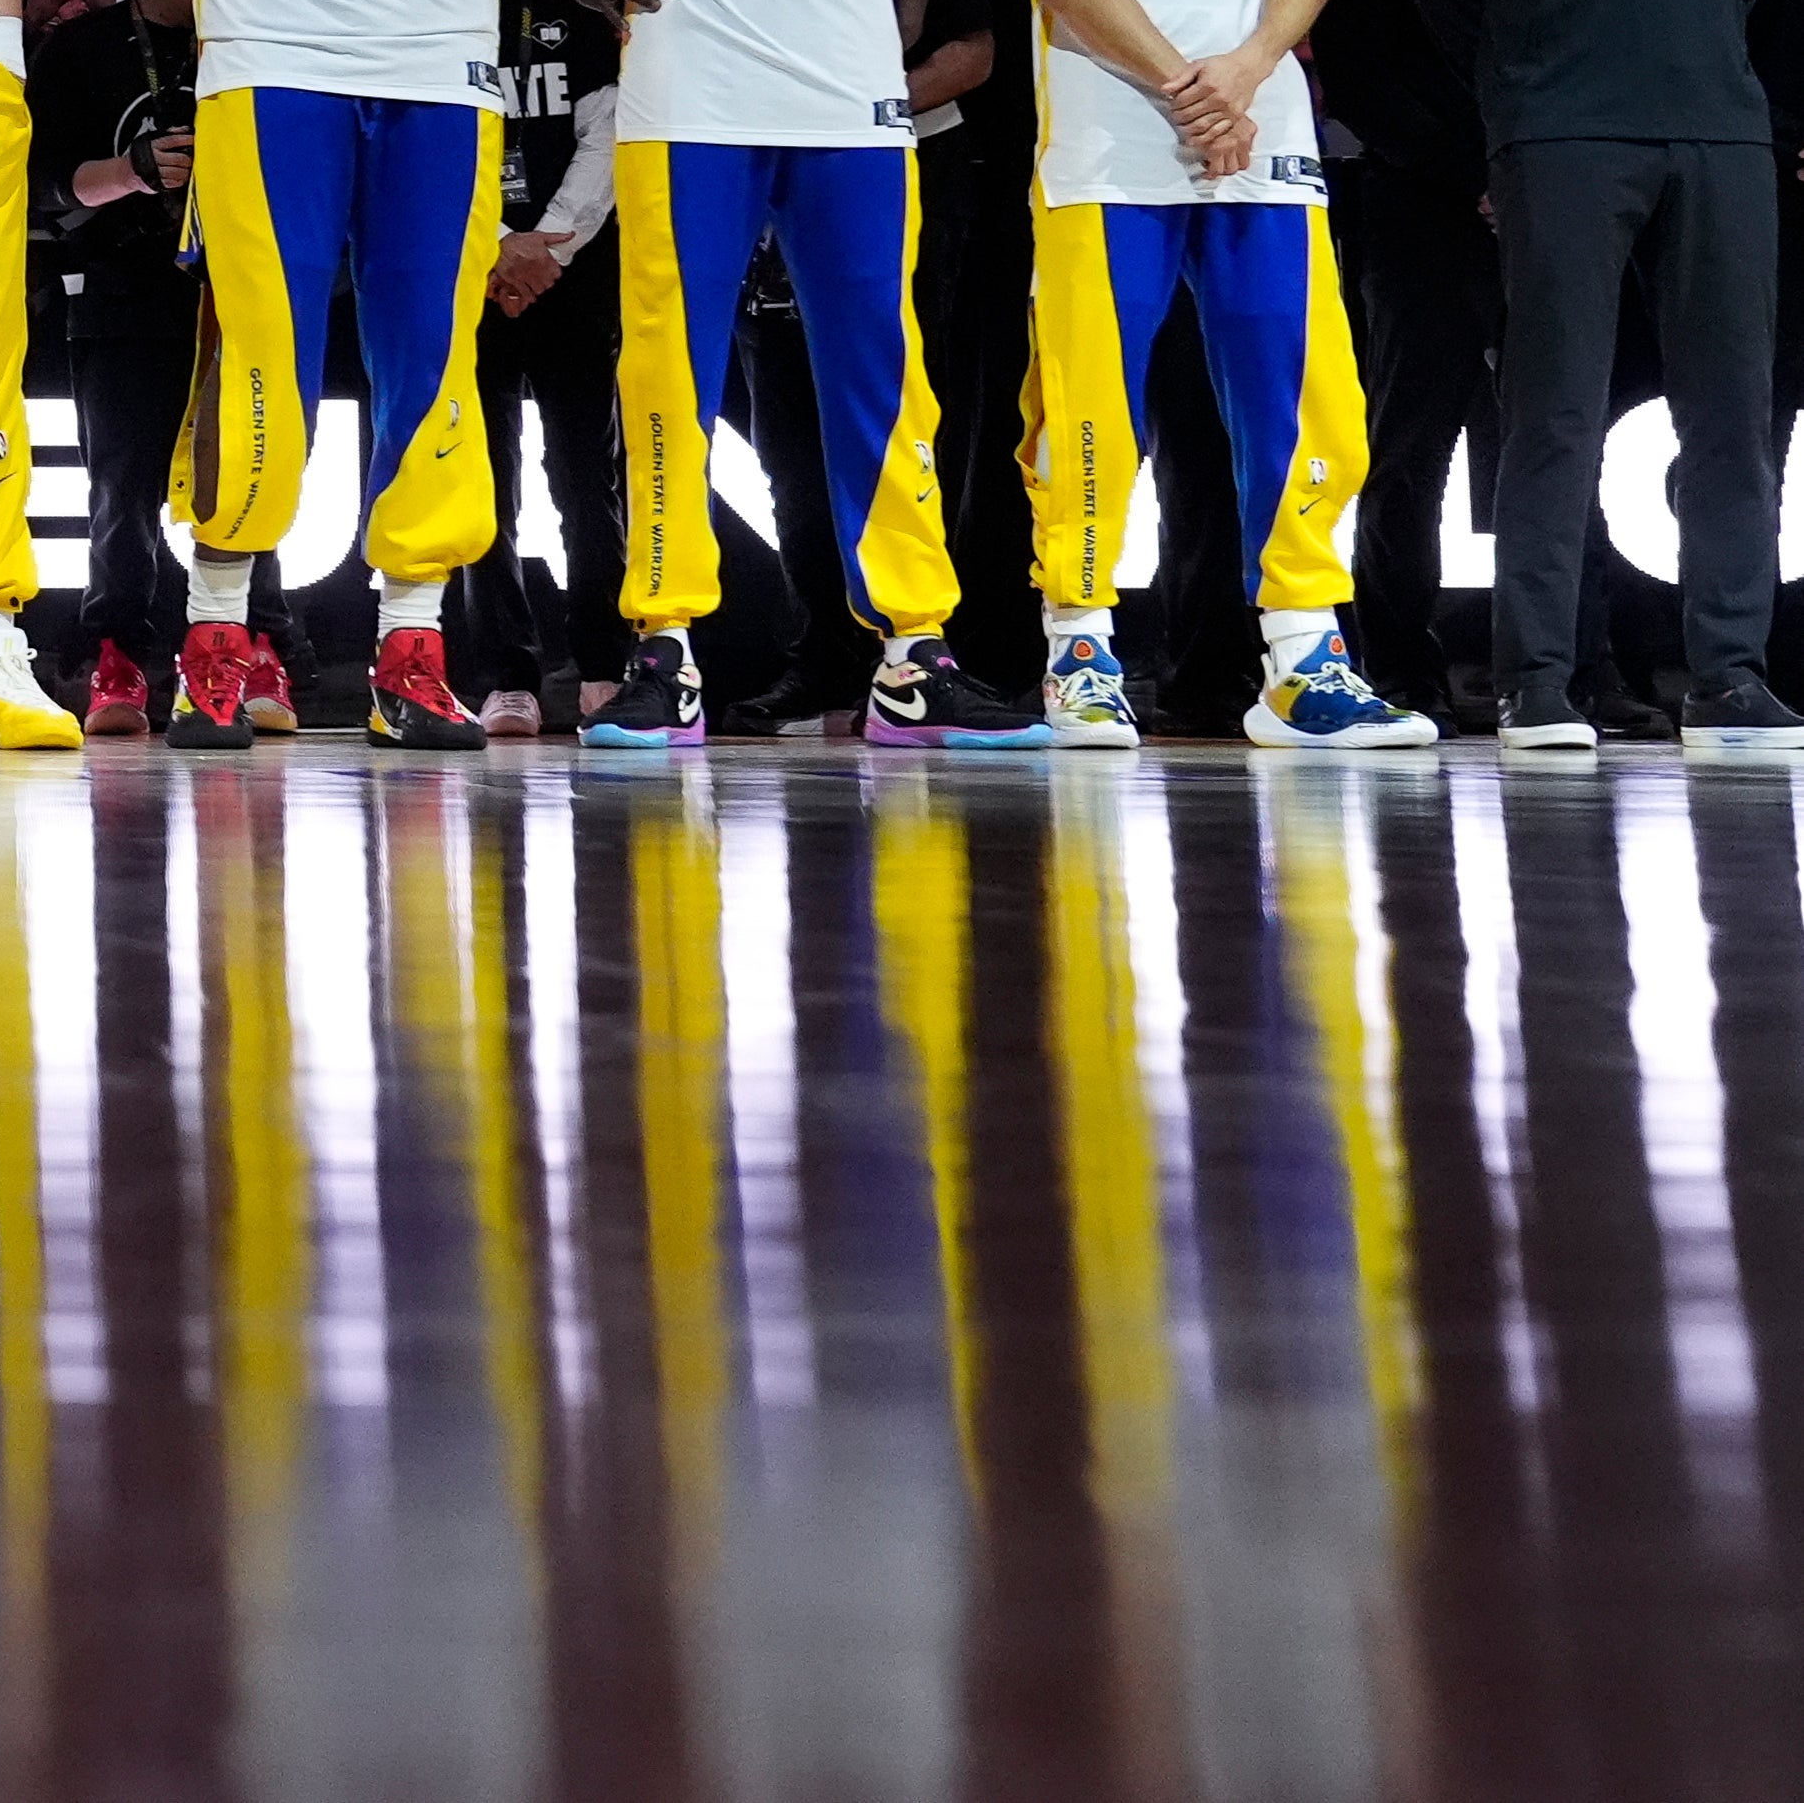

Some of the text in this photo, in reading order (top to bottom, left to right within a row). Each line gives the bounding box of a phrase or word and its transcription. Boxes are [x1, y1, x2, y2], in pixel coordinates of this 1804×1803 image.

[250, 368, 265, 474] GOLDEN STATE
[649, 412, 663, 470] GOLDEN
[1081, 421, 1095, 476] GOLDEN
[652, 474, 664, 516] STATE
[1084, 479, 1095, 517] STATE
